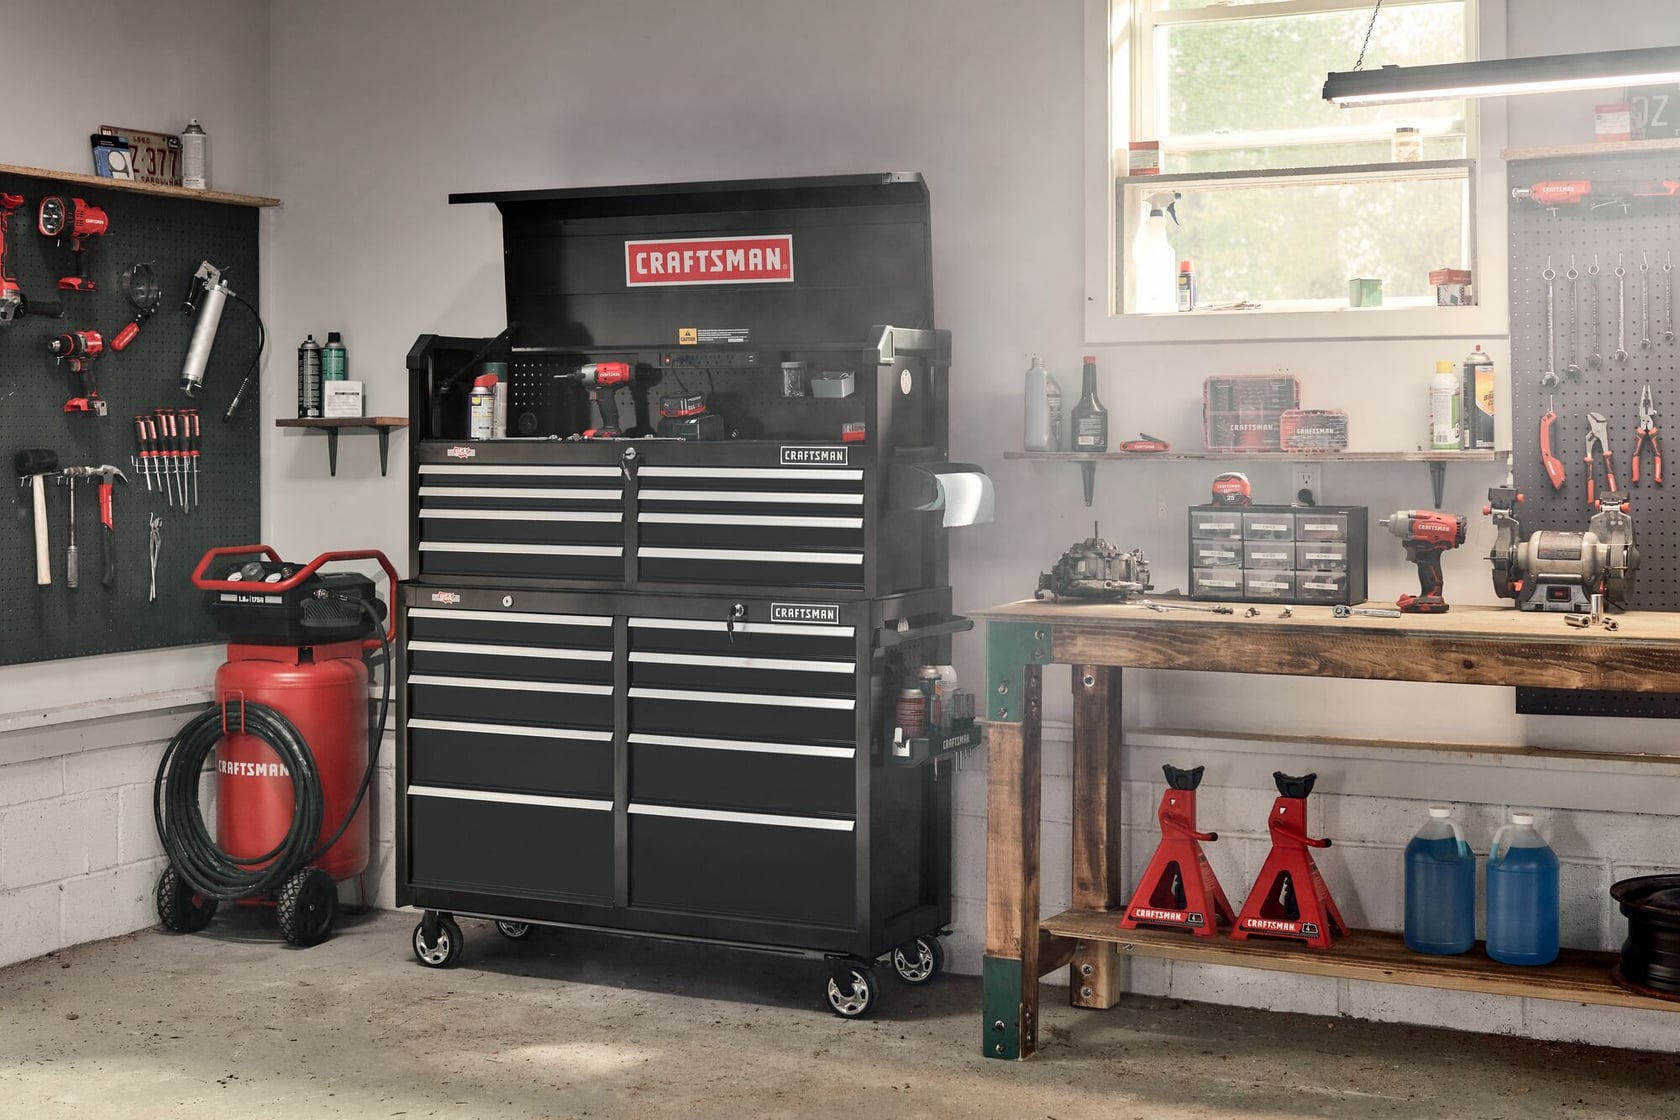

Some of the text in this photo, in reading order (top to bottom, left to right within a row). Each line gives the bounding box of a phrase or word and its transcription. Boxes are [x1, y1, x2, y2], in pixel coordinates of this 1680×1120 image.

[636, 247, 781, 275] CRAFTSMAN
[785, 450, 843, 461] CRAFTSMAN
[775, 607, 834, 620] CRAFTSMAN
[218, 759, 290, 777] CRAFTSMAN
[1136, 909, 1181, 921] CRAFTSMAN
[1247, 919, 1295, 931] CRAFTSMAN
